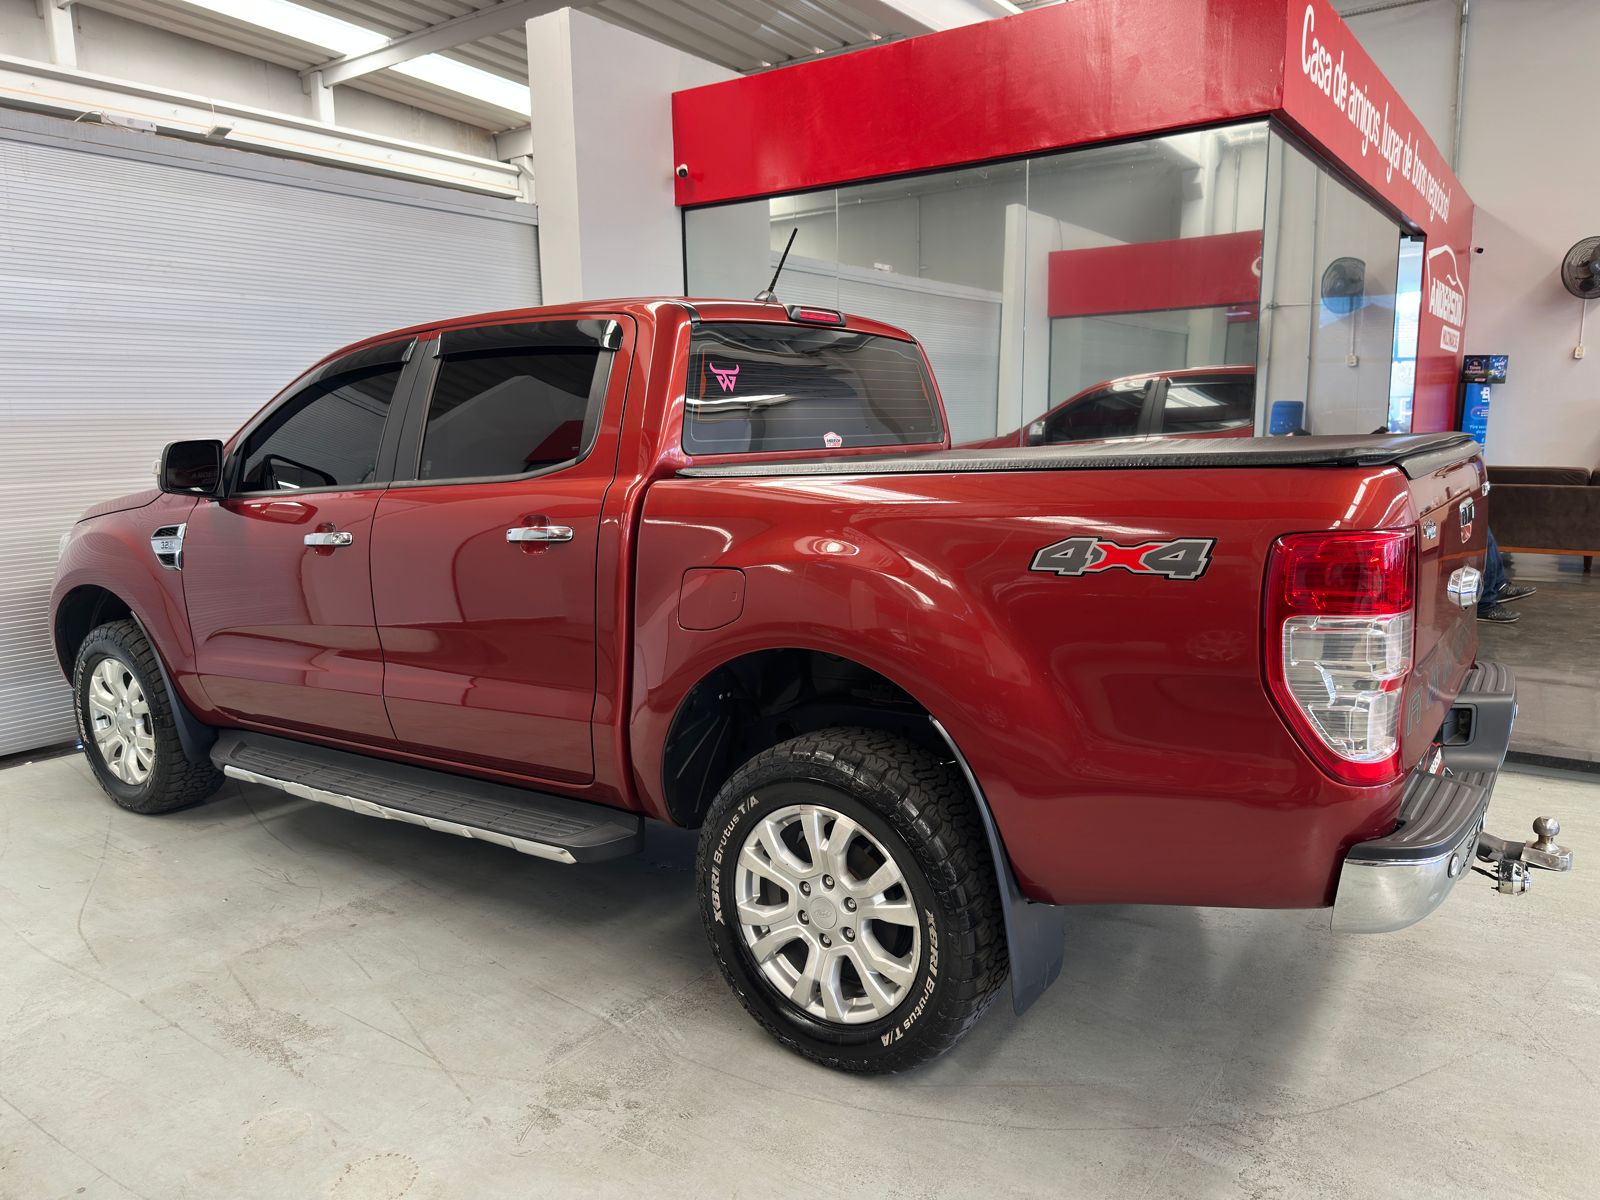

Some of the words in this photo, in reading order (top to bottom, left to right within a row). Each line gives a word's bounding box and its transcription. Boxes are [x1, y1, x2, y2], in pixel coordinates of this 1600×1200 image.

[1302, 4, 1332, 97] Casa
[1333, 50, 1348, 113] de
[1348, 80, 1381, 157] amigos,
[1381, 101, 1403, 184] lugar
[1402, 131, 1413, 181] de
[1412, 139, 1428, 197] bons
[737, 795, 760, 815] T/A
[713, 813, 740, 865] Brutus
[711, 864, 726, 927] XBRI
[924, 907, 939, 978] XBRI
[902, 976, 935, 1030] Brutus
[880, 1026, 904, 1047] T/A
